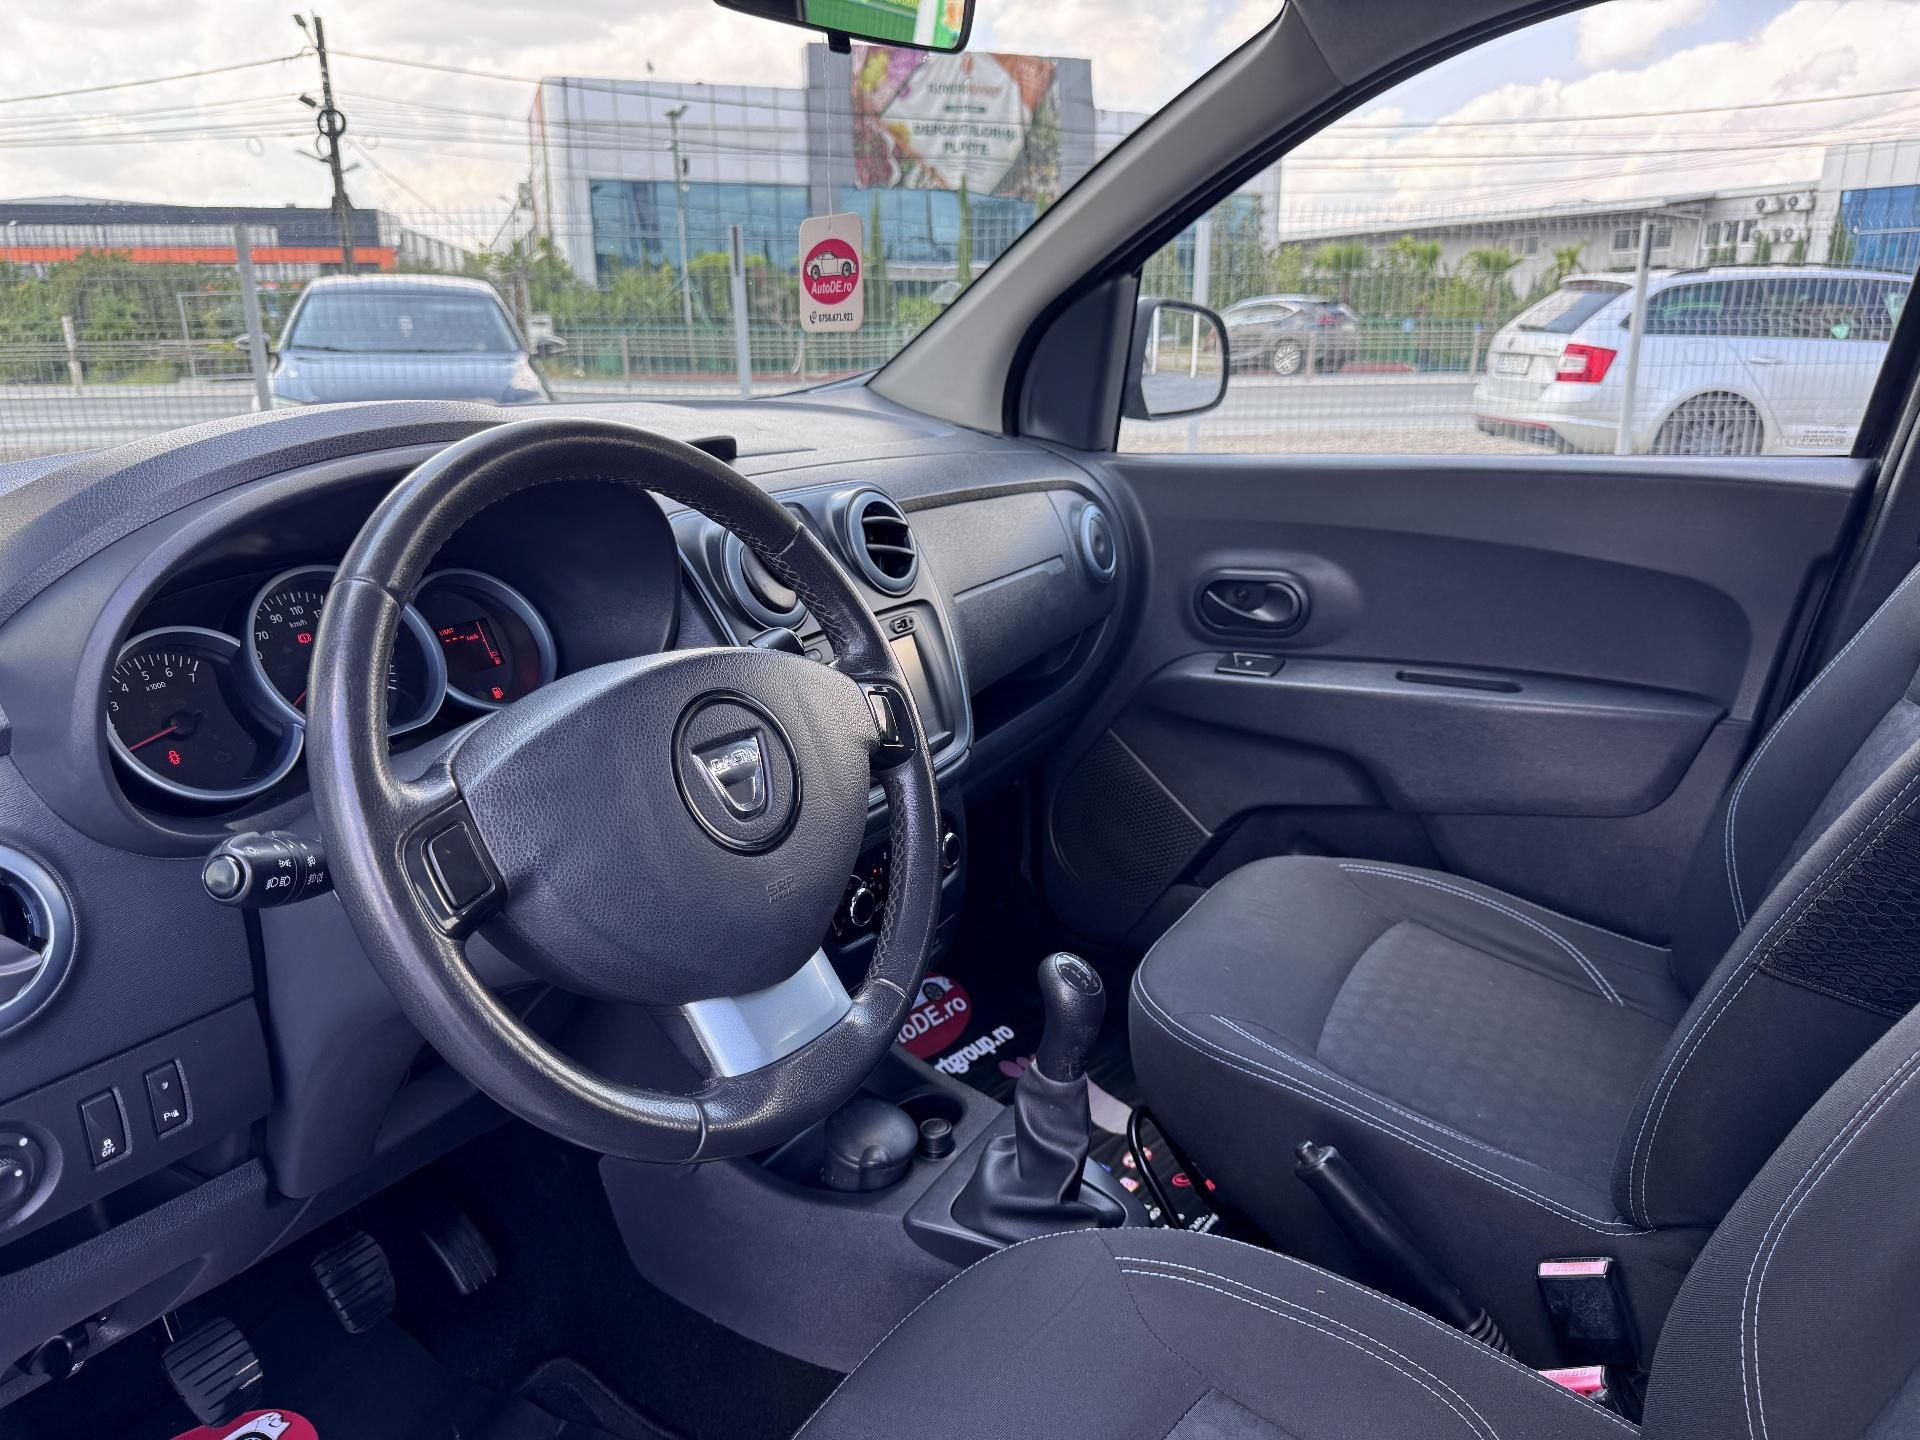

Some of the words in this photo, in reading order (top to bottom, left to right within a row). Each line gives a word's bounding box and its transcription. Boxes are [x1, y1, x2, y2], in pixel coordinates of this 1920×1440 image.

[811, 280, 853, 295] AutoDE.ro
[290, 605, 304, 616] 110
[269, 613, 283, 624] 90
[289, 619, 307, 628] km/h
[255, 630, 269, 641] 70
[141, 670, 150, 681] 5
[165, 667, 173, 678] 6
[188, 672, 195, 683] 7
[121, 682, 129, 693] 4
[110, 701, 120, 712] 3
[934, 1025, 1015, 1074] rtgroup.ro
